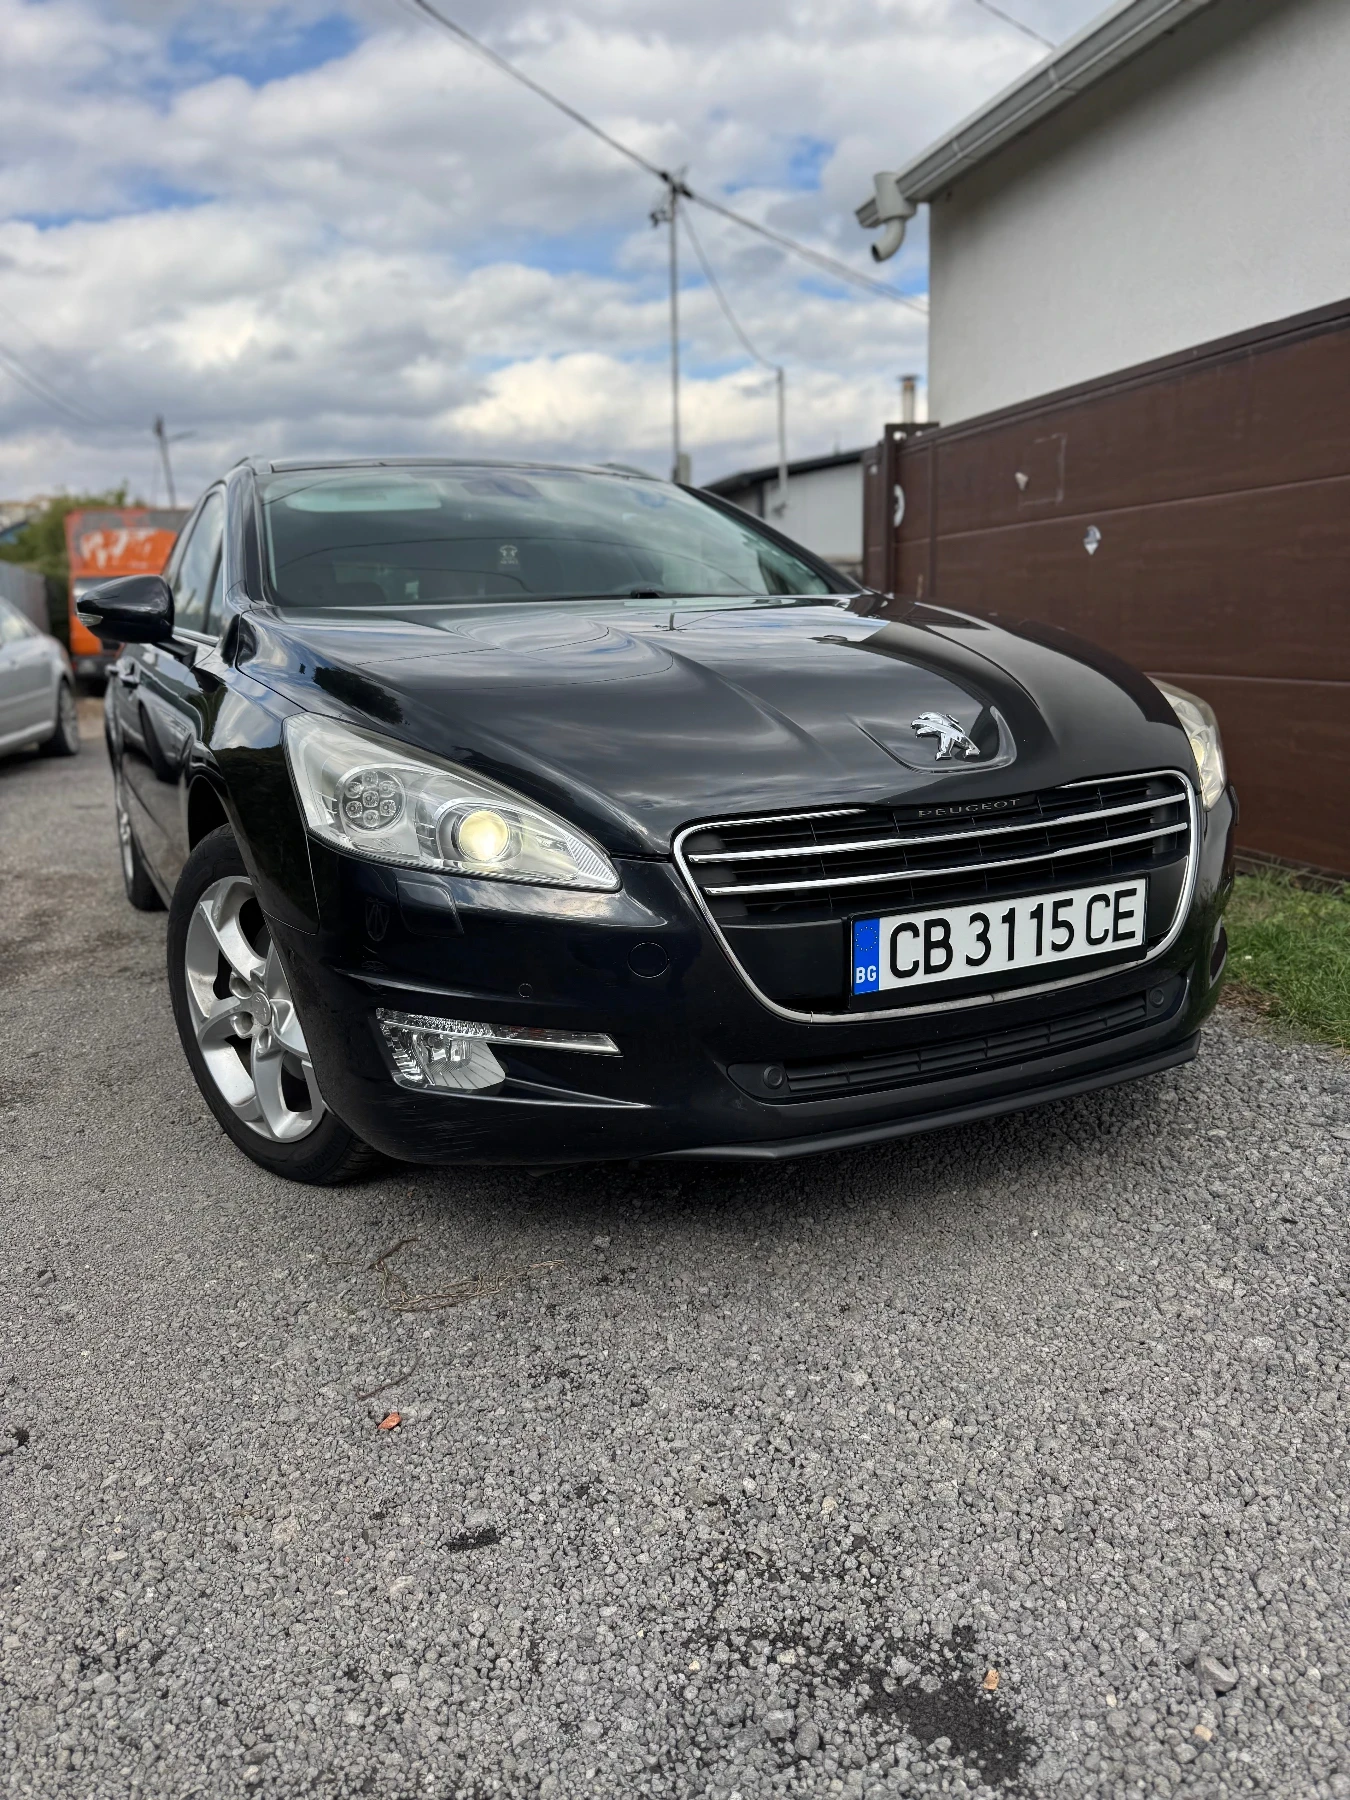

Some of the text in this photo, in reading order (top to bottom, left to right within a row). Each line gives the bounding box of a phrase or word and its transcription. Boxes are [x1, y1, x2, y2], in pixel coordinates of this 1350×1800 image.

[917, 798, 1020, 818] PEUGEOT
[889, 887, 1139, 979] CB 3115 CE
[855, 966, 877, 984] BG
